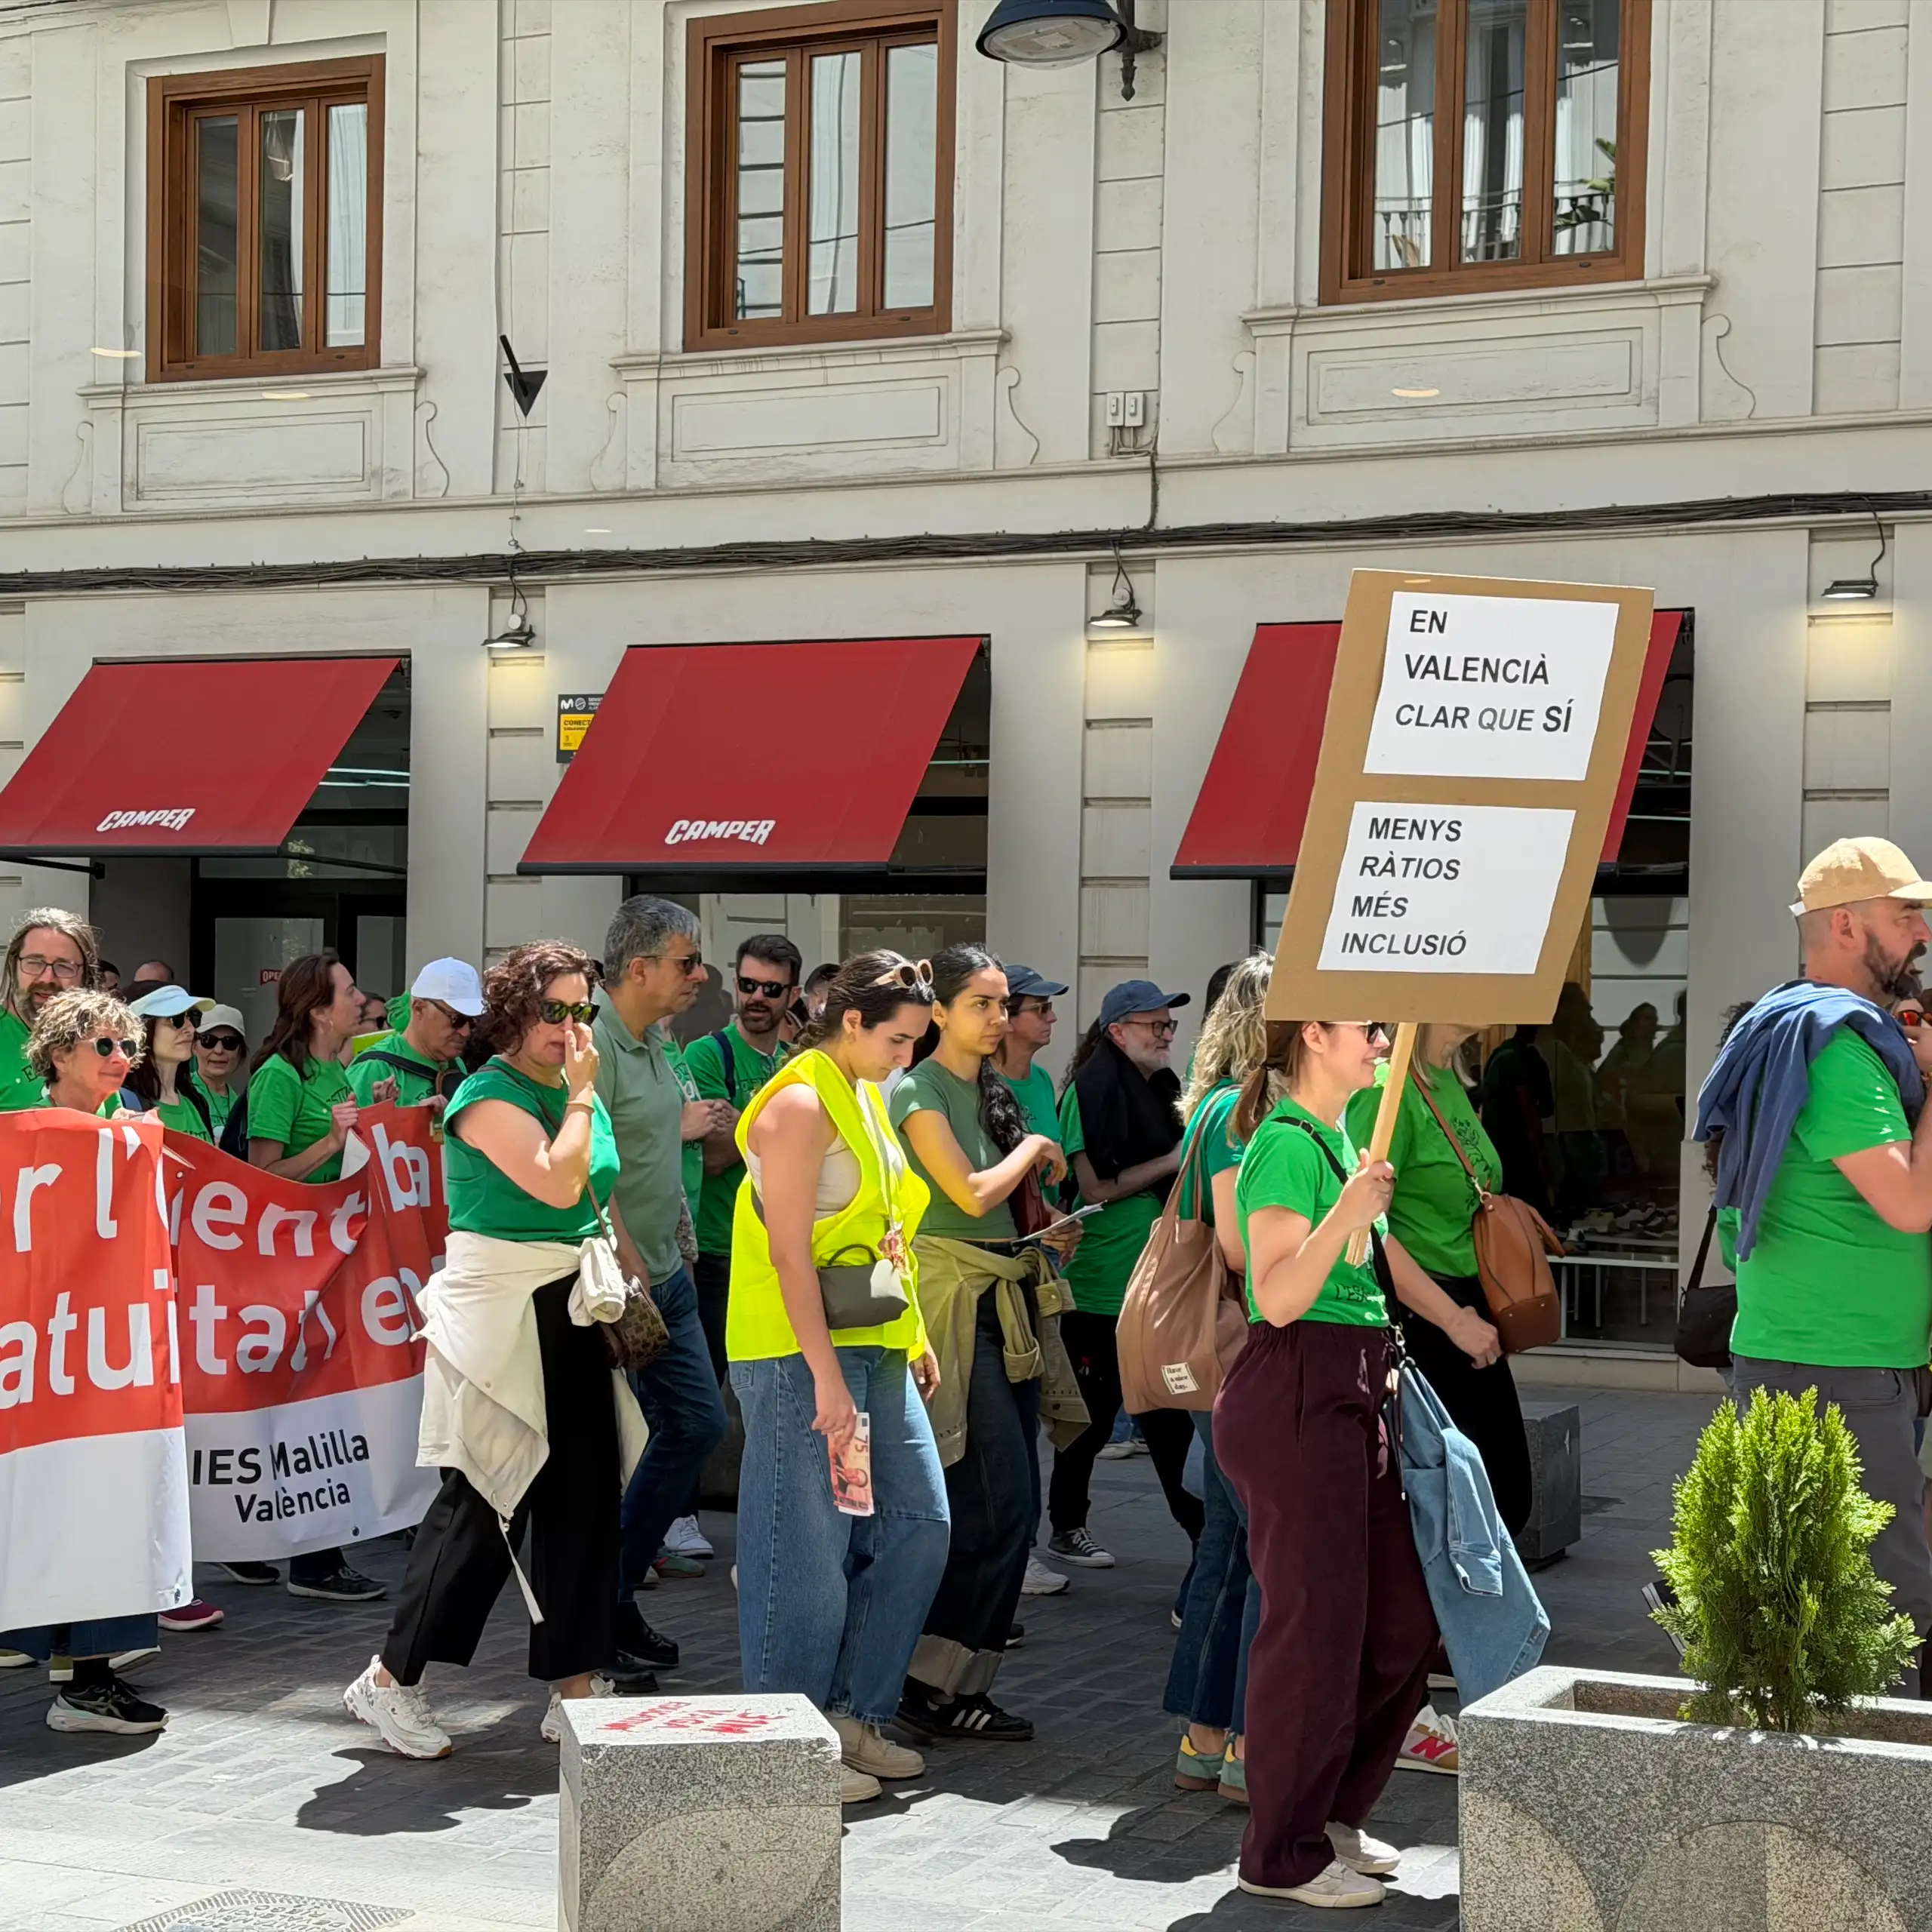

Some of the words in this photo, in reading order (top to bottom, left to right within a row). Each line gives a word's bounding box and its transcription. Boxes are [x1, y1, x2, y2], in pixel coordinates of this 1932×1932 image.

[1409, 610, 1447, 634] EN
[1404, 653, 1549, 685] VALENCIÀ
[1395, 704, 1470, 729] CLAR
[1478, 707, 1535, 732] QUE
[1542, 698, 1574, 733] SÍ
[96, 808, 196, 833] CAMPER
[664, 820, 777, 846] CAMPER
[1368, 817, 1463, 842] MENYS
[1359, 851, 1461, 881] RÀTIOS
[1351, 891, 1408, 918] MÉS
[1341, 930, 1467, 956] INCLUSIÓ
[192, 1447, 263, 1485] IES
[269, 1429, 370, 1481] Malilla
[854, 1435, 869, 1453] 75
[234, 1478, 352, 1523] València
